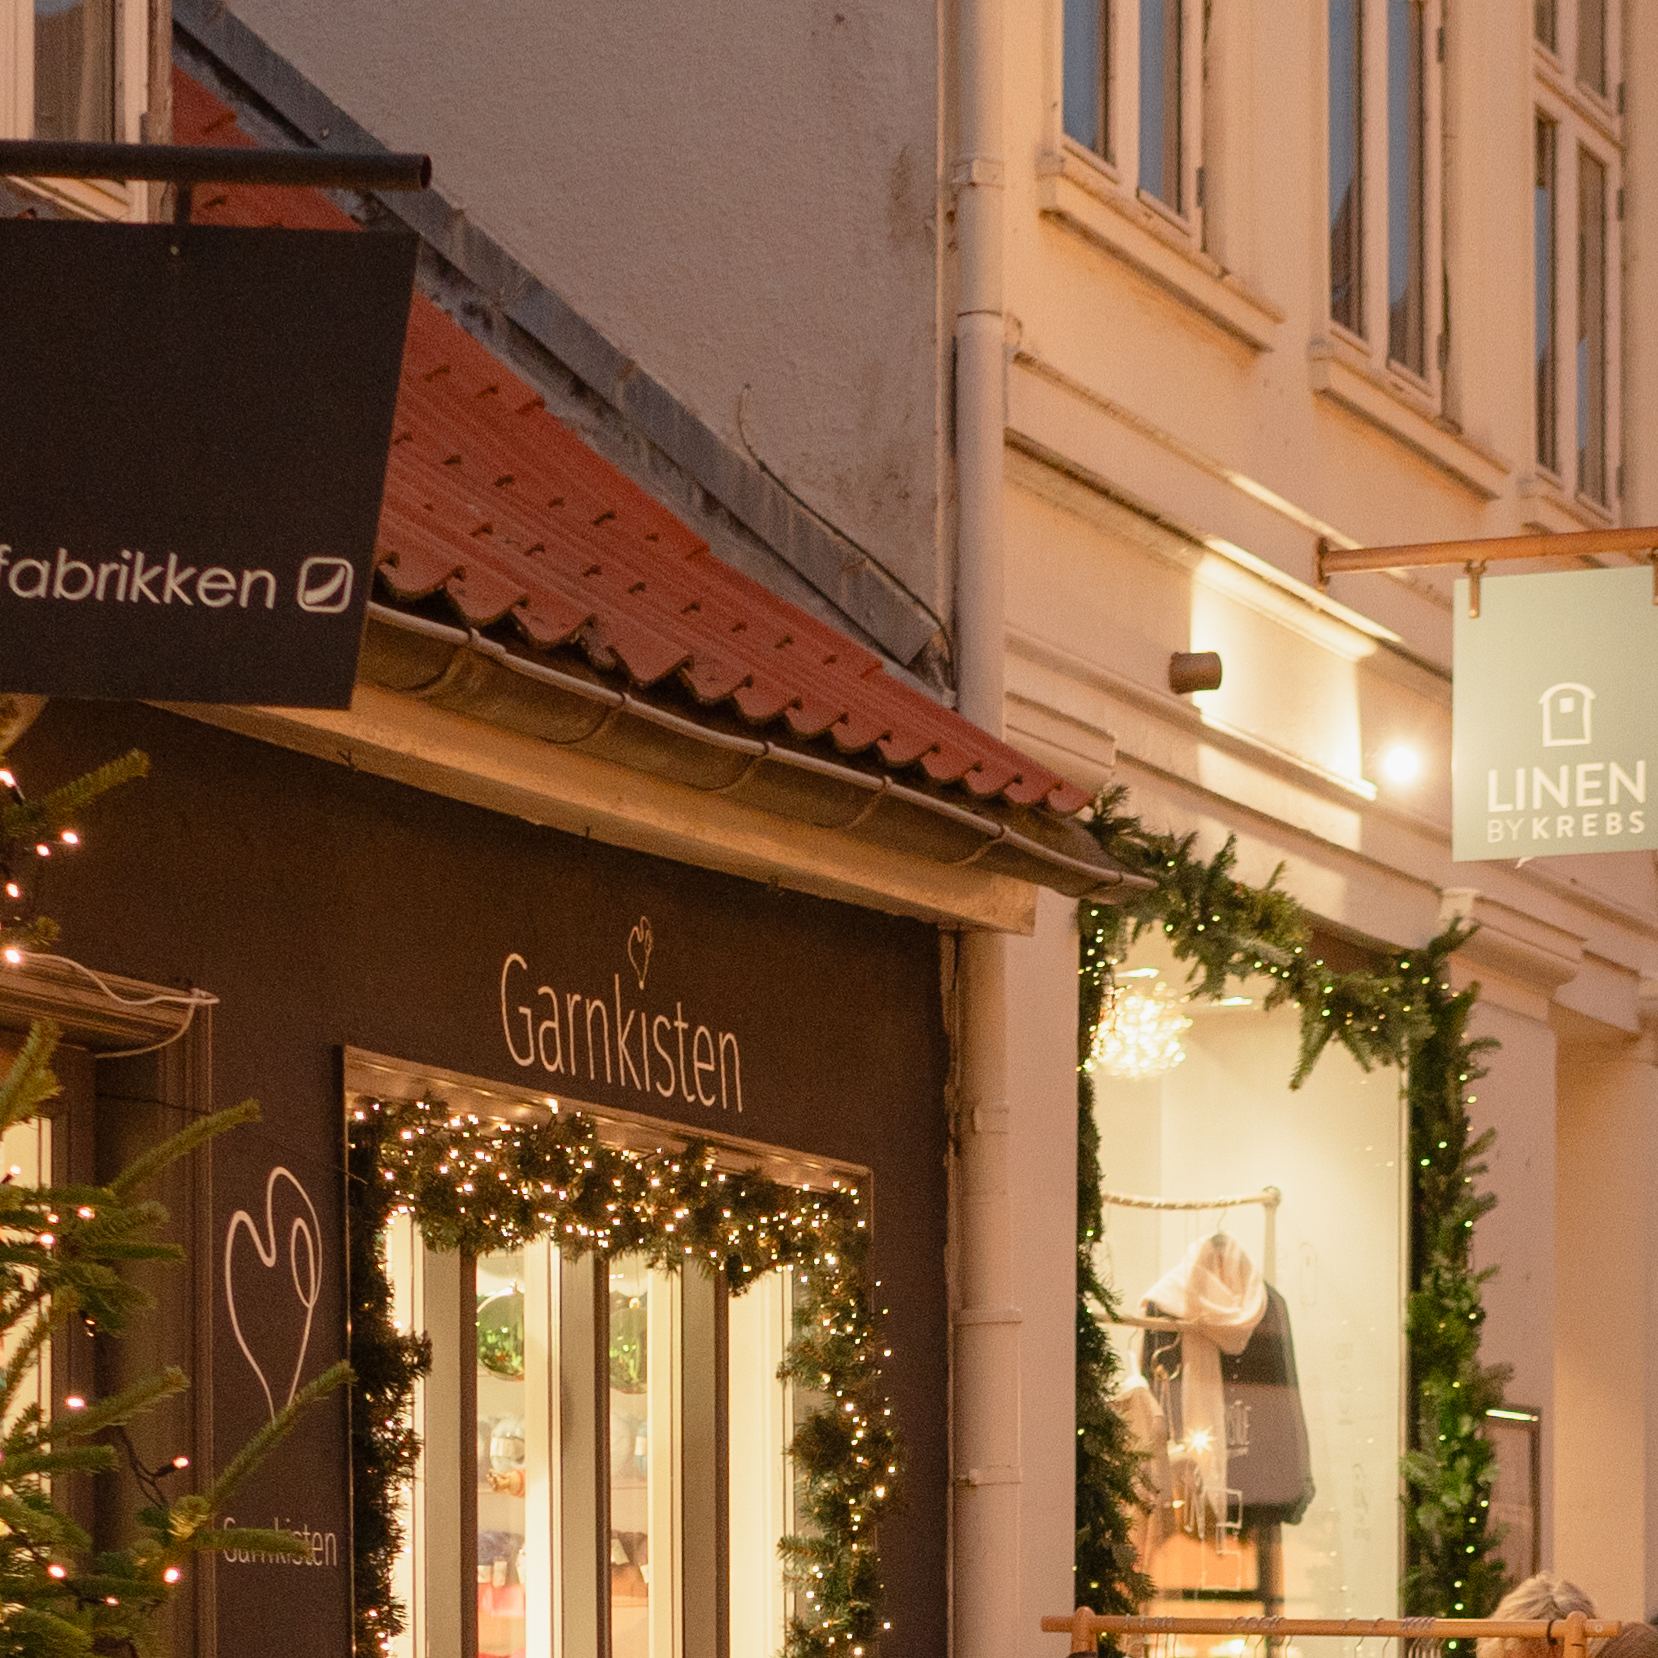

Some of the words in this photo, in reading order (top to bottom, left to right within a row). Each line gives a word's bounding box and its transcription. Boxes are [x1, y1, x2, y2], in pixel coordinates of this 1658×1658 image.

[0, 543, 278, 610] fabrikken
[1486, 757, 1647, 814] LINEN
[1486, 818, 1526, 844] BY
[1532, 809, 1646, 841] KREBS
[500, 951, 744, 1115] Garnkisten
